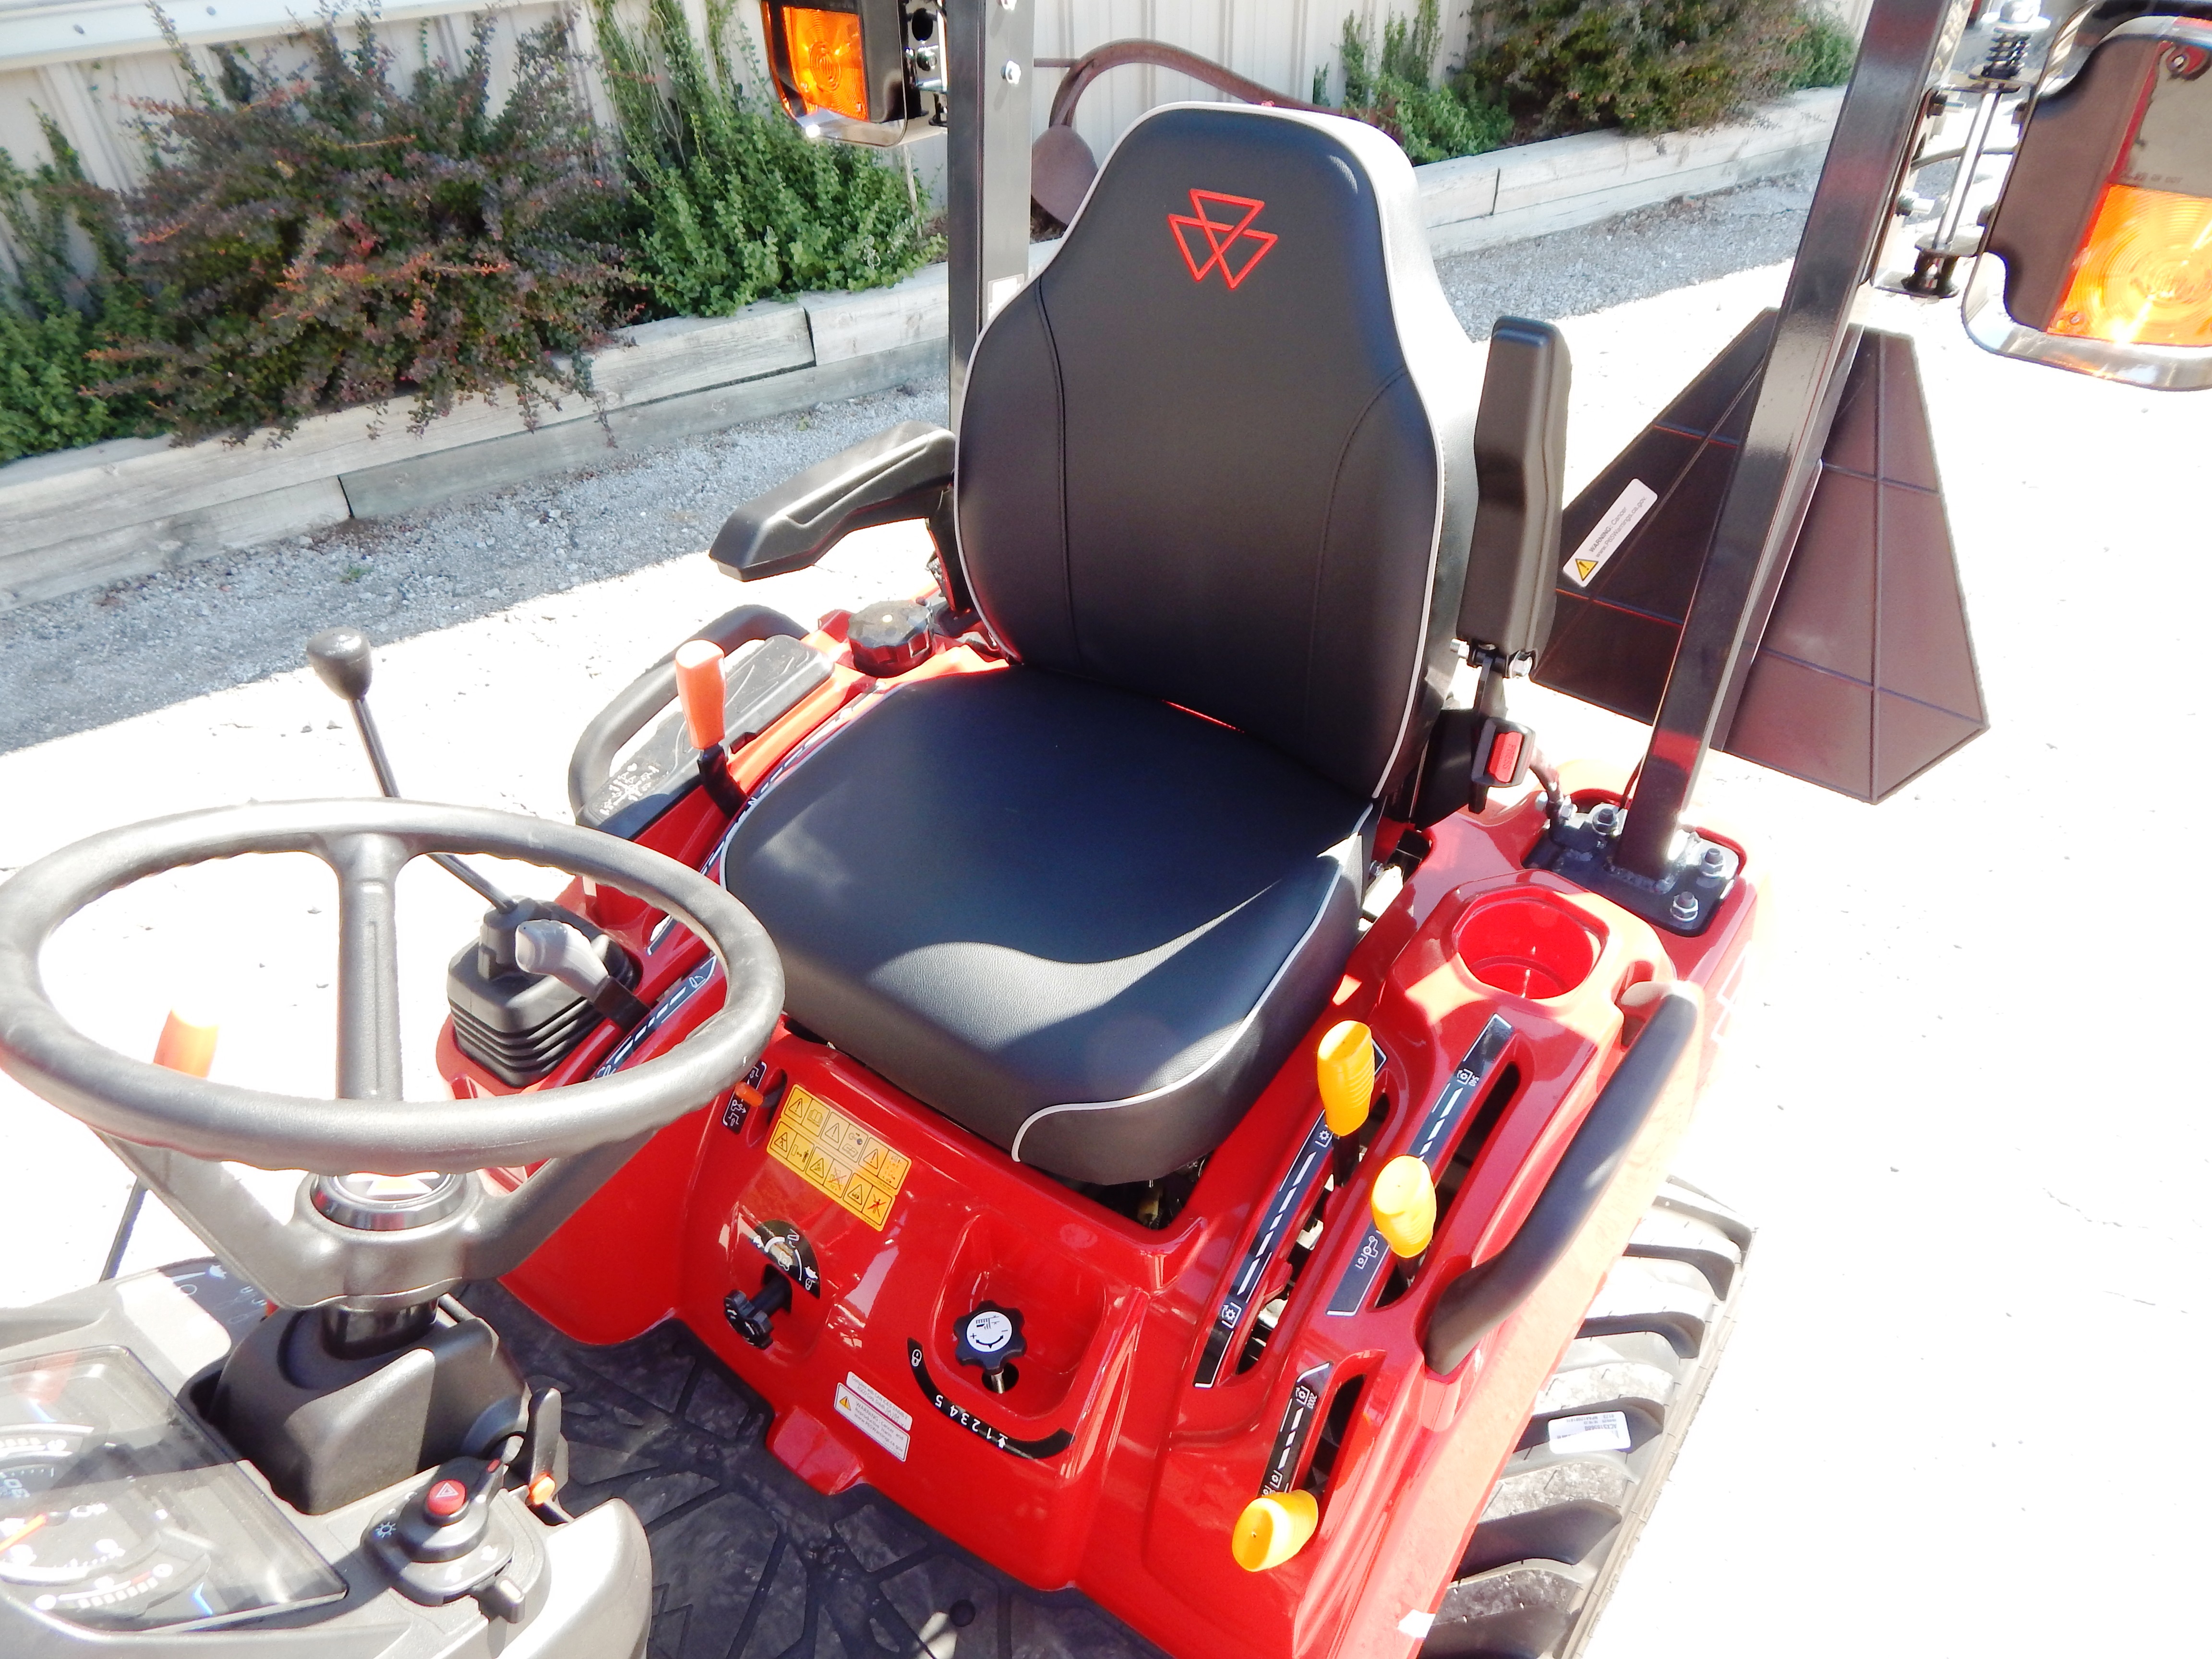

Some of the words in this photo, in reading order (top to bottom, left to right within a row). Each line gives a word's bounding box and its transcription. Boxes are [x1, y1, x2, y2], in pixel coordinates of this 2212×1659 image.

[1589, 525, 1613, 552] WARNING:
[1611, 507, 1626, 525] Cancer
[1469, 1075, 1479, 1086] 540
[935, 1395, 943, 1408] 5
[1307, 1393, 1317, 1409] 2000
[950, 1405, 958, 1417] 4
[961, 1413, 969, 1425] 3
[972, 1419, 981, 1432] 2
[986, 1428, 992, 1439] 1
